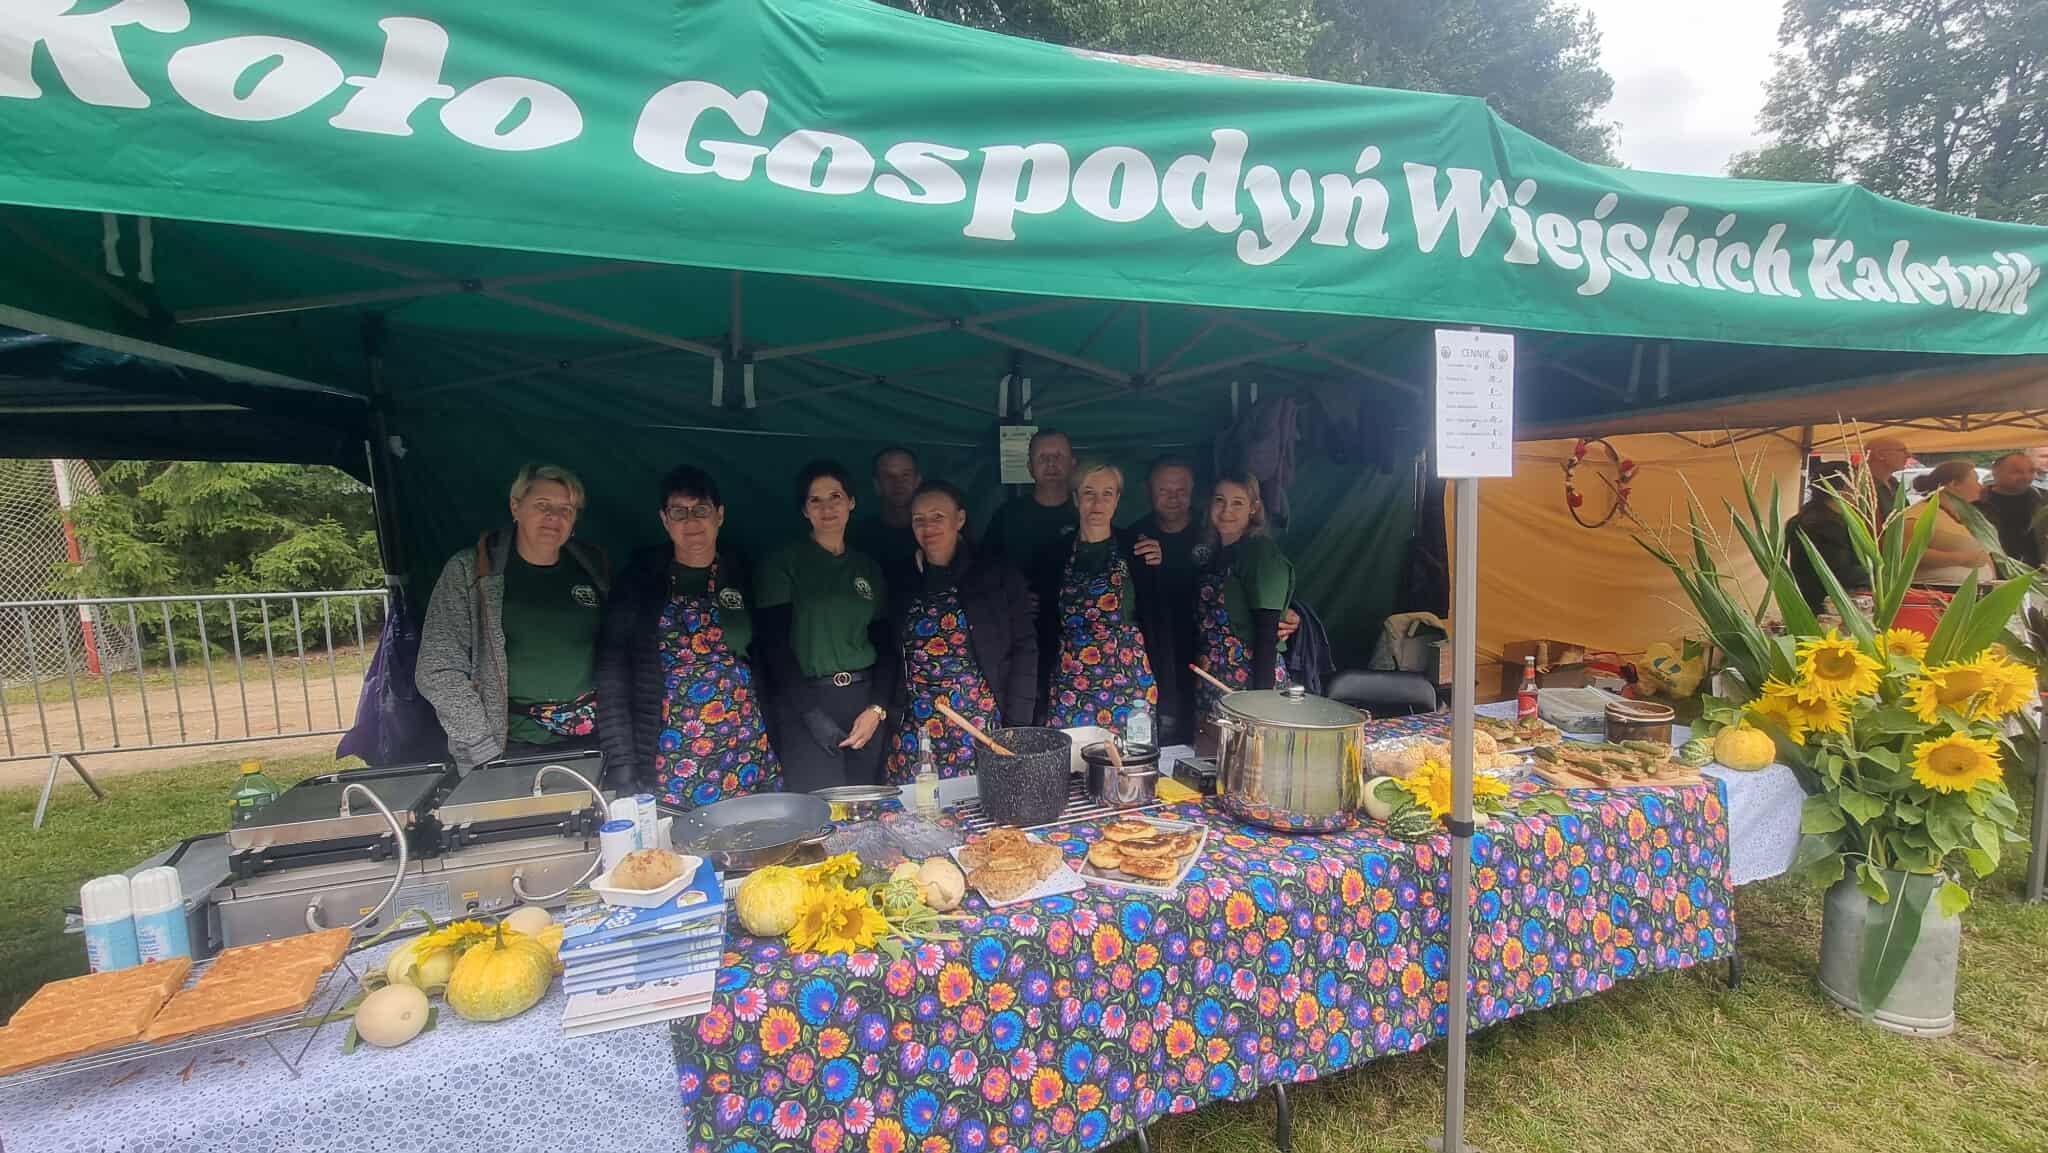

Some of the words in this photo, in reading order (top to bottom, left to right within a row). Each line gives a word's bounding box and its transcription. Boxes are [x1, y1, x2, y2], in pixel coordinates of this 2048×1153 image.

[633, 80, 1388, 265] Gospodyń
[1403, 162, 1801, 297] Wiejskich
[1808, 238, 2040, 315] Kaletnik
